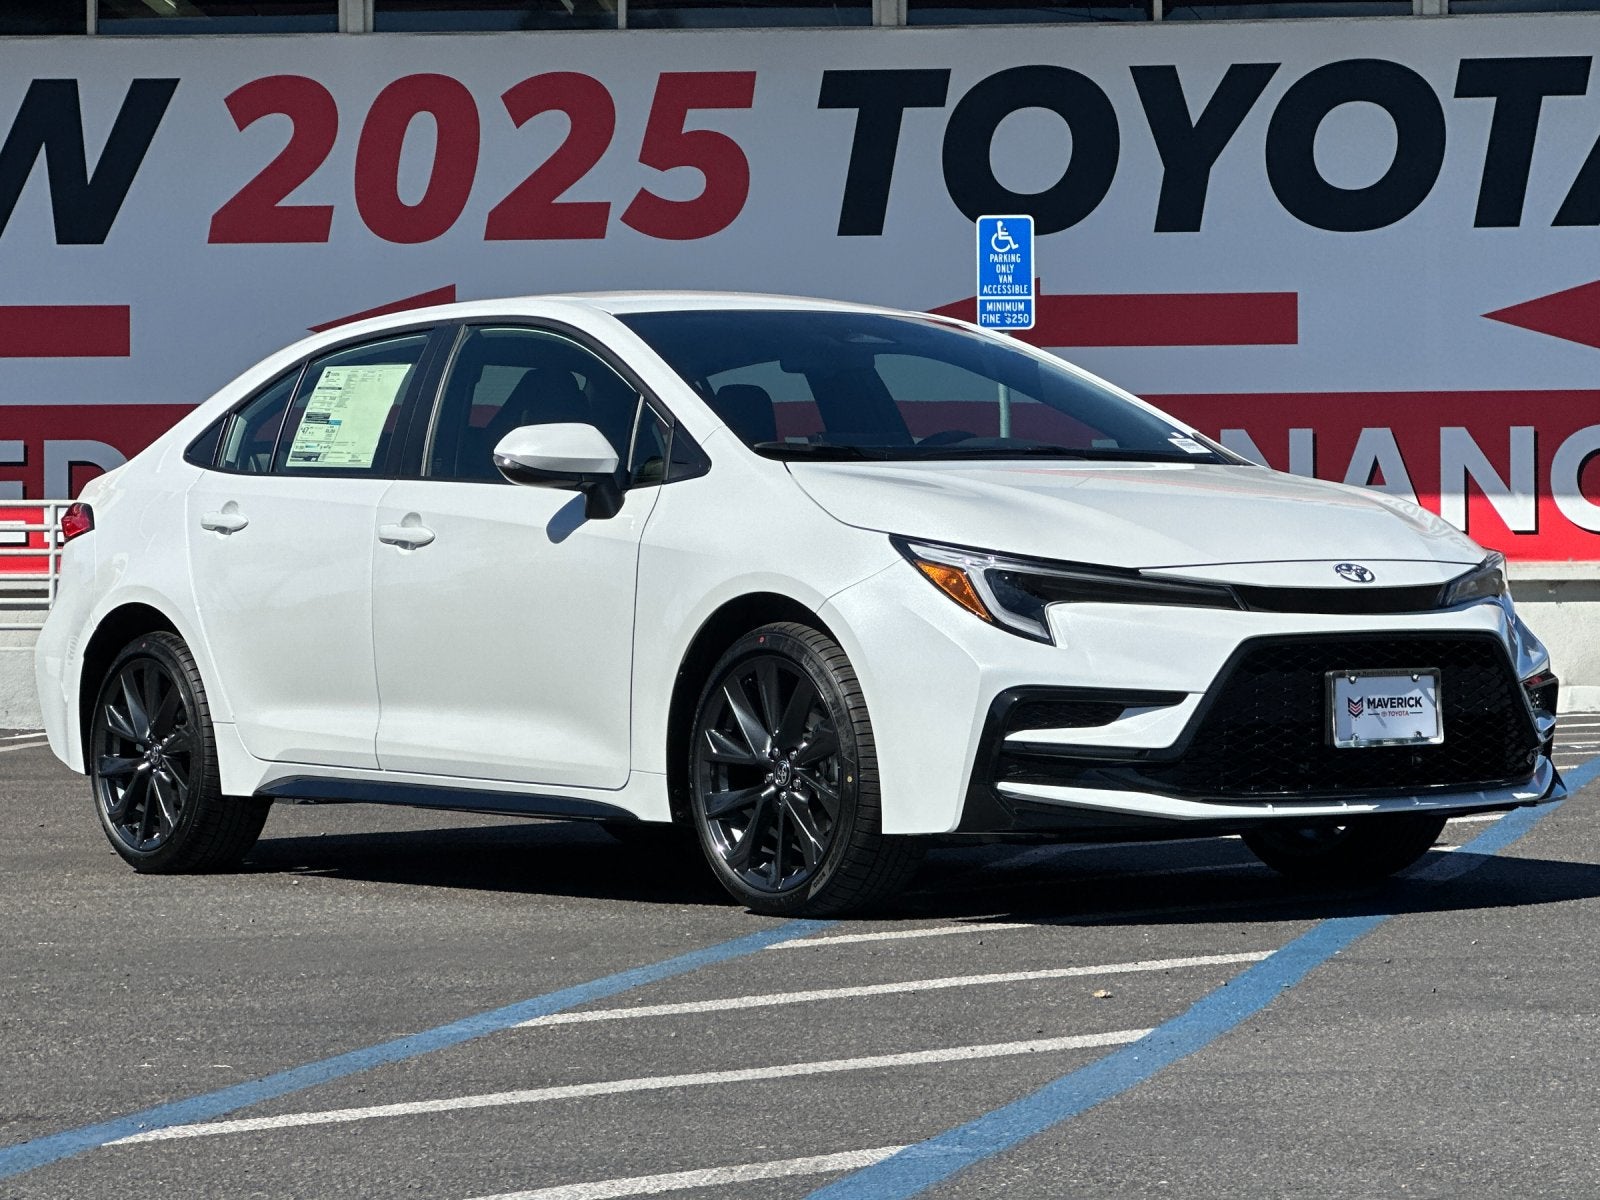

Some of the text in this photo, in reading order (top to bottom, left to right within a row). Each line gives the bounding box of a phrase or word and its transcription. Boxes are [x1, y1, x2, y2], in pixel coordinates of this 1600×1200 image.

[210, 73, 755, 243] 2025
[989, 253, 1021, 263] PARKING
[995, 264, 1015, 274] ONLY
[998, 274, 1013, 284] VAN
[982, 285, 1028, 294] ACCESSIBLE
[986, 302, 1025, 312] MINIMUM
[981, 313, 1029, 324] FINE $250
[1367, 696, 1423, 709] MAVERICK
